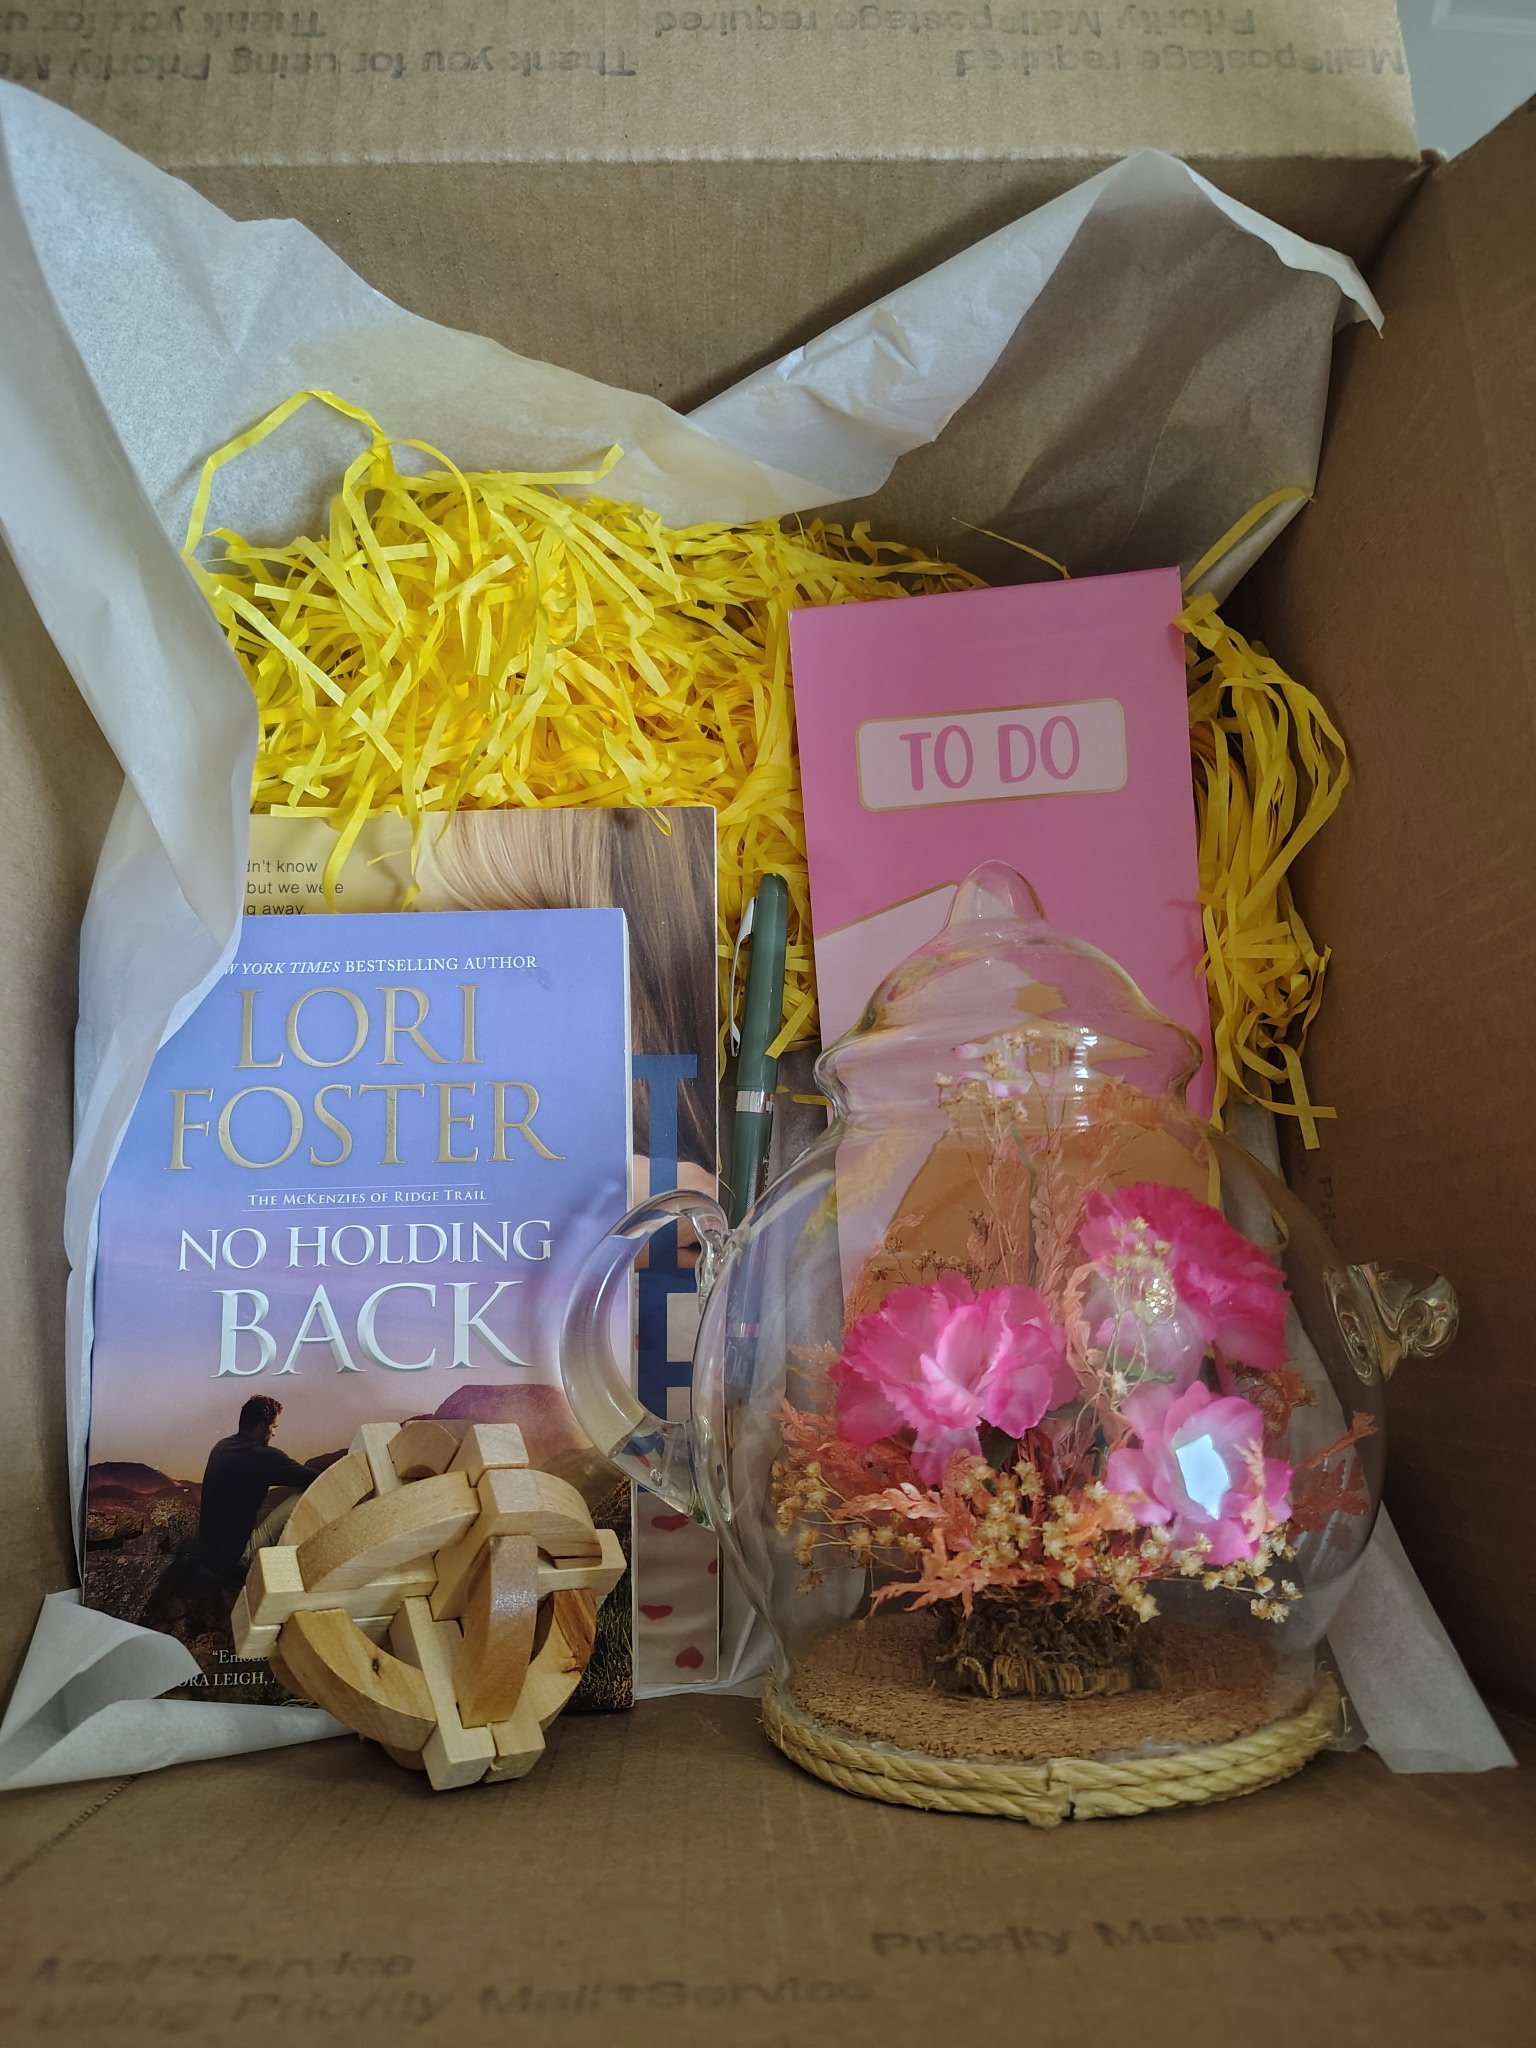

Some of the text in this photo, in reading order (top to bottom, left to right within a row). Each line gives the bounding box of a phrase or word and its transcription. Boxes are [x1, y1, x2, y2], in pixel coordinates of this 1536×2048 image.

[655, 5, 818, 37] required
[230, 47, 338, 79] using
[351, 51, 406, 80] for
[422, 47, 495, 73] you
[509, 50, 637, 77] Thank
[899, 715, 1080, 792] TO DO
[277, 859, 318, 873] know
[247, 881, 344, 894] but we wee
[242, 962, 287, 975] YORK
[289, 961, 341, 974] TIMES
[345, 957, 459, 973] BESTSELLING
[464, 956, 538, 970] AUTHOR
[232, 983, 485, 1070] LORI
[164, 1079, 568, 1172] FOSTER
[176, 1219, 553, 1273] NO HOLDING
[210, 1281, 535, 1380] BACK
[214, 1671, 268, 1687] LEIGH,
